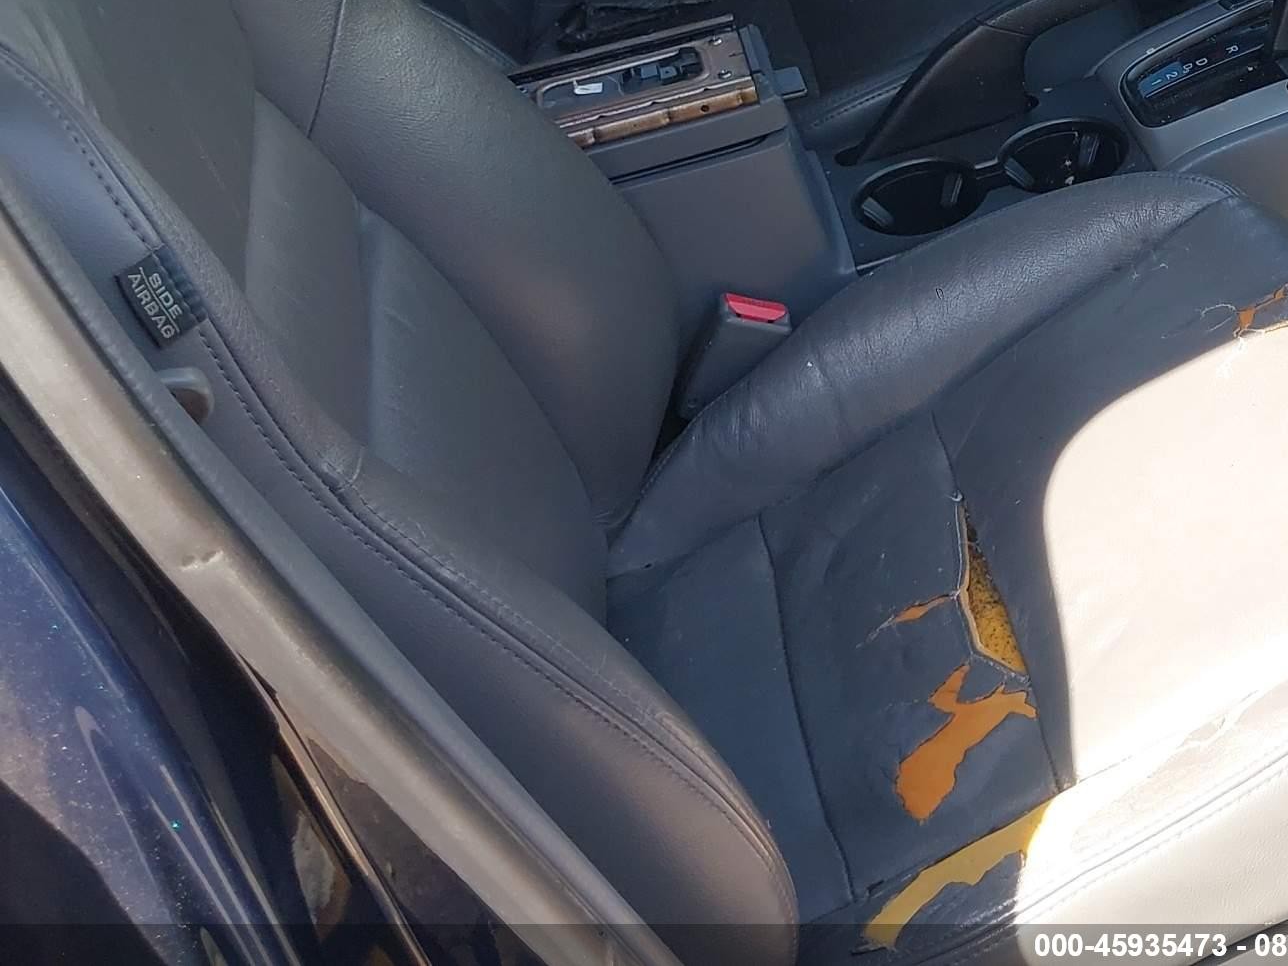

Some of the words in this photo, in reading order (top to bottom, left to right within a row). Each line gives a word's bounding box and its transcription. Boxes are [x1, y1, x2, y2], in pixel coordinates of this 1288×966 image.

[1225, 45, 1239, 54] R
[1195, 57, 1208, 66] D
[1166, 71, 1178, 80] 2
[149, 273, 183, 319] SIDE
[128, 274, 176, 339] AIRBAG
